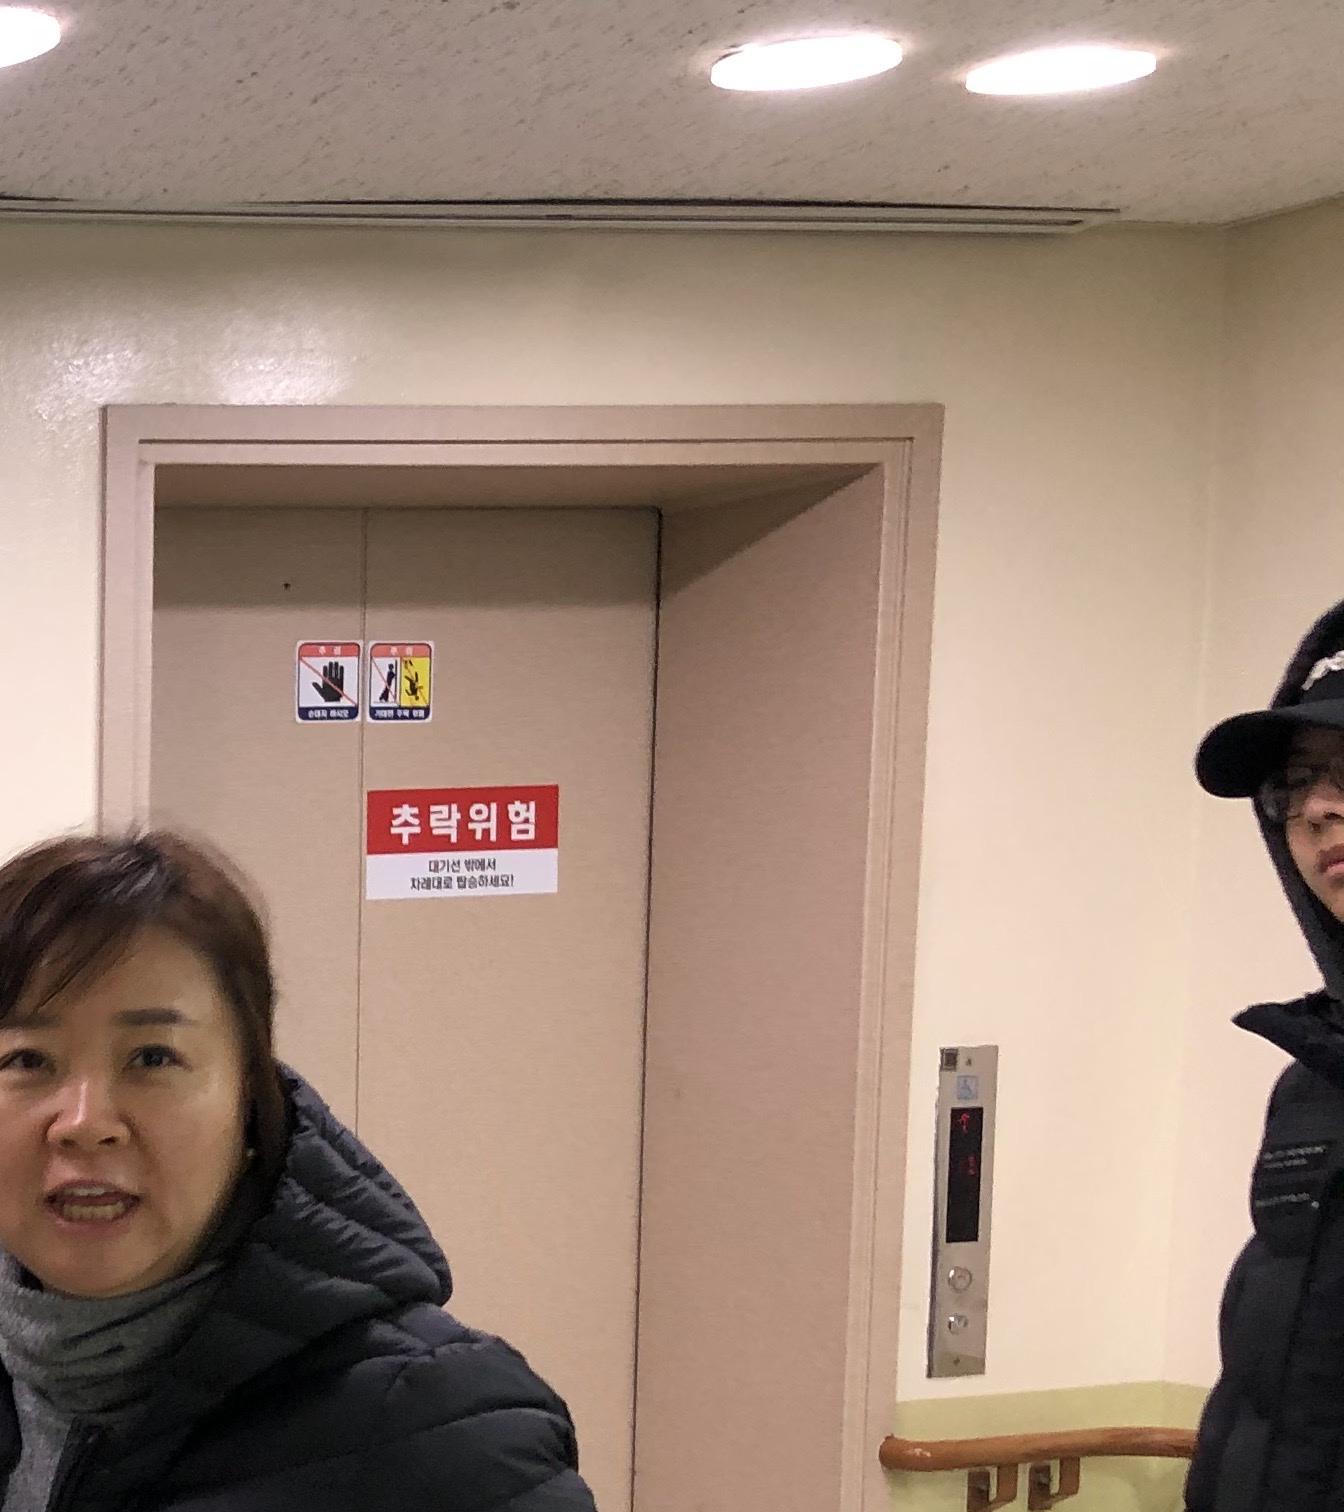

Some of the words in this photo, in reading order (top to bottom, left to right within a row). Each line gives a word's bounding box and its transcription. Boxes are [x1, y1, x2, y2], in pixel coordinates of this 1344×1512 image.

[390, 800, 536, 845] 추락위험
[428, 859, 460, 873] 대기선
[464, 858, 496, 872] 밖에서
[410, 876, 453, 891] 차례대로
[456, 874, 514, 889] 탑승하세요!
